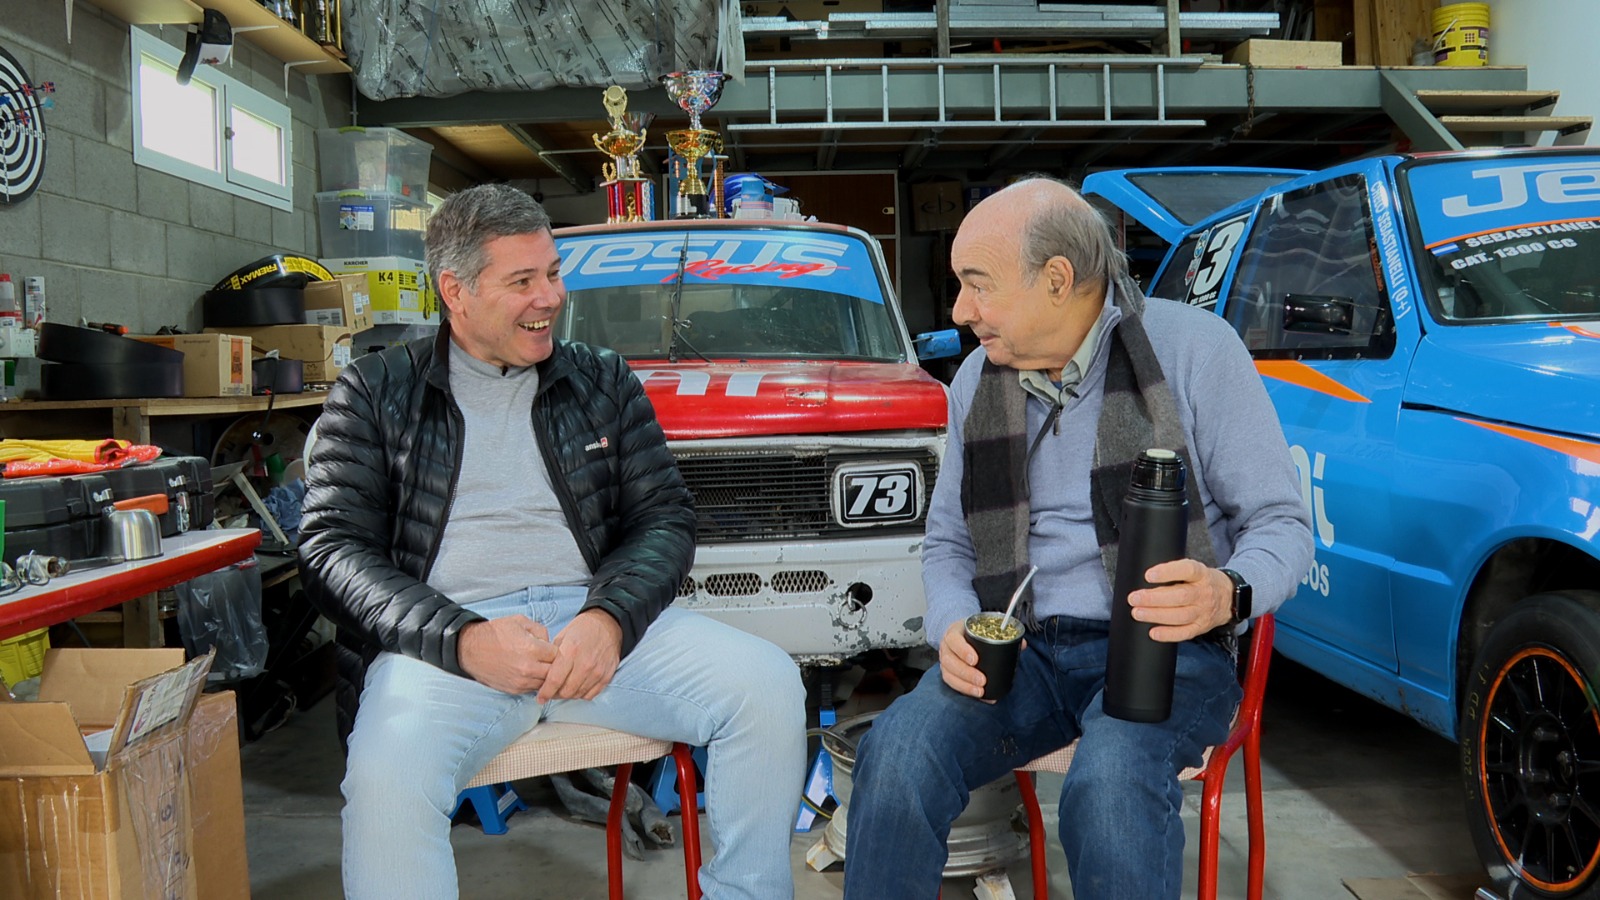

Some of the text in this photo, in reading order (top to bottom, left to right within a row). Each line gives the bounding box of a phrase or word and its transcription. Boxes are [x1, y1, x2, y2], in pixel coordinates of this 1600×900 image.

[1465, 220, 1600, 248] SEBASTIANEL
[1193, 221, 1245, 296] 3
[1378, 211, 1405, 288] SEBASTIANELLI
[1450, 237, 1578, 270] CAT. 1300 CC
[240, 263, 278, 285] FREMAX
[378, 272, 394, 282] K 4
[660, 259, 851, 283] Racing
[848, 474, 910, 515] 73
